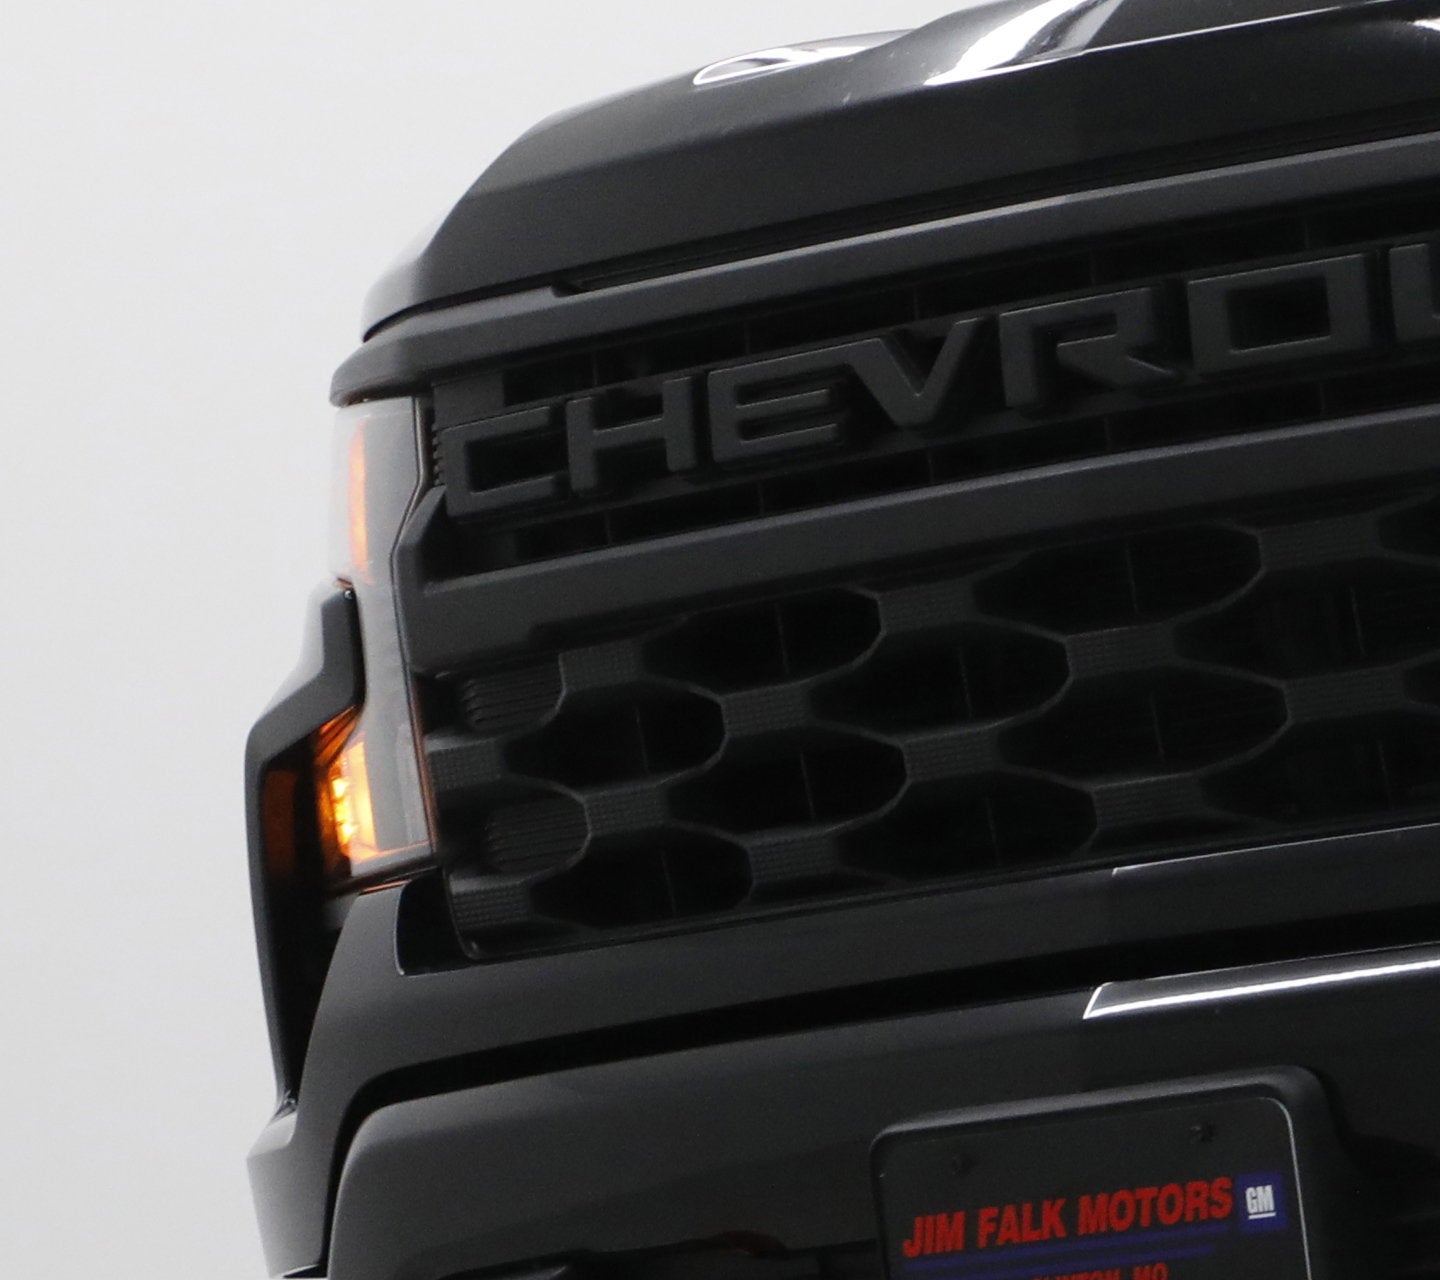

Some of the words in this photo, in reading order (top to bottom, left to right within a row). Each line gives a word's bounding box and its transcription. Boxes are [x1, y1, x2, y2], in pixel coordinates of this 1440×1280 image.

[903, 1211, 966, 1257] JIM
[977, 1198, 1067, 1247] FALK
[1077, 1176, 1234, 1236] MOTORS
[1245, 1184, 1275, 1215] GM
